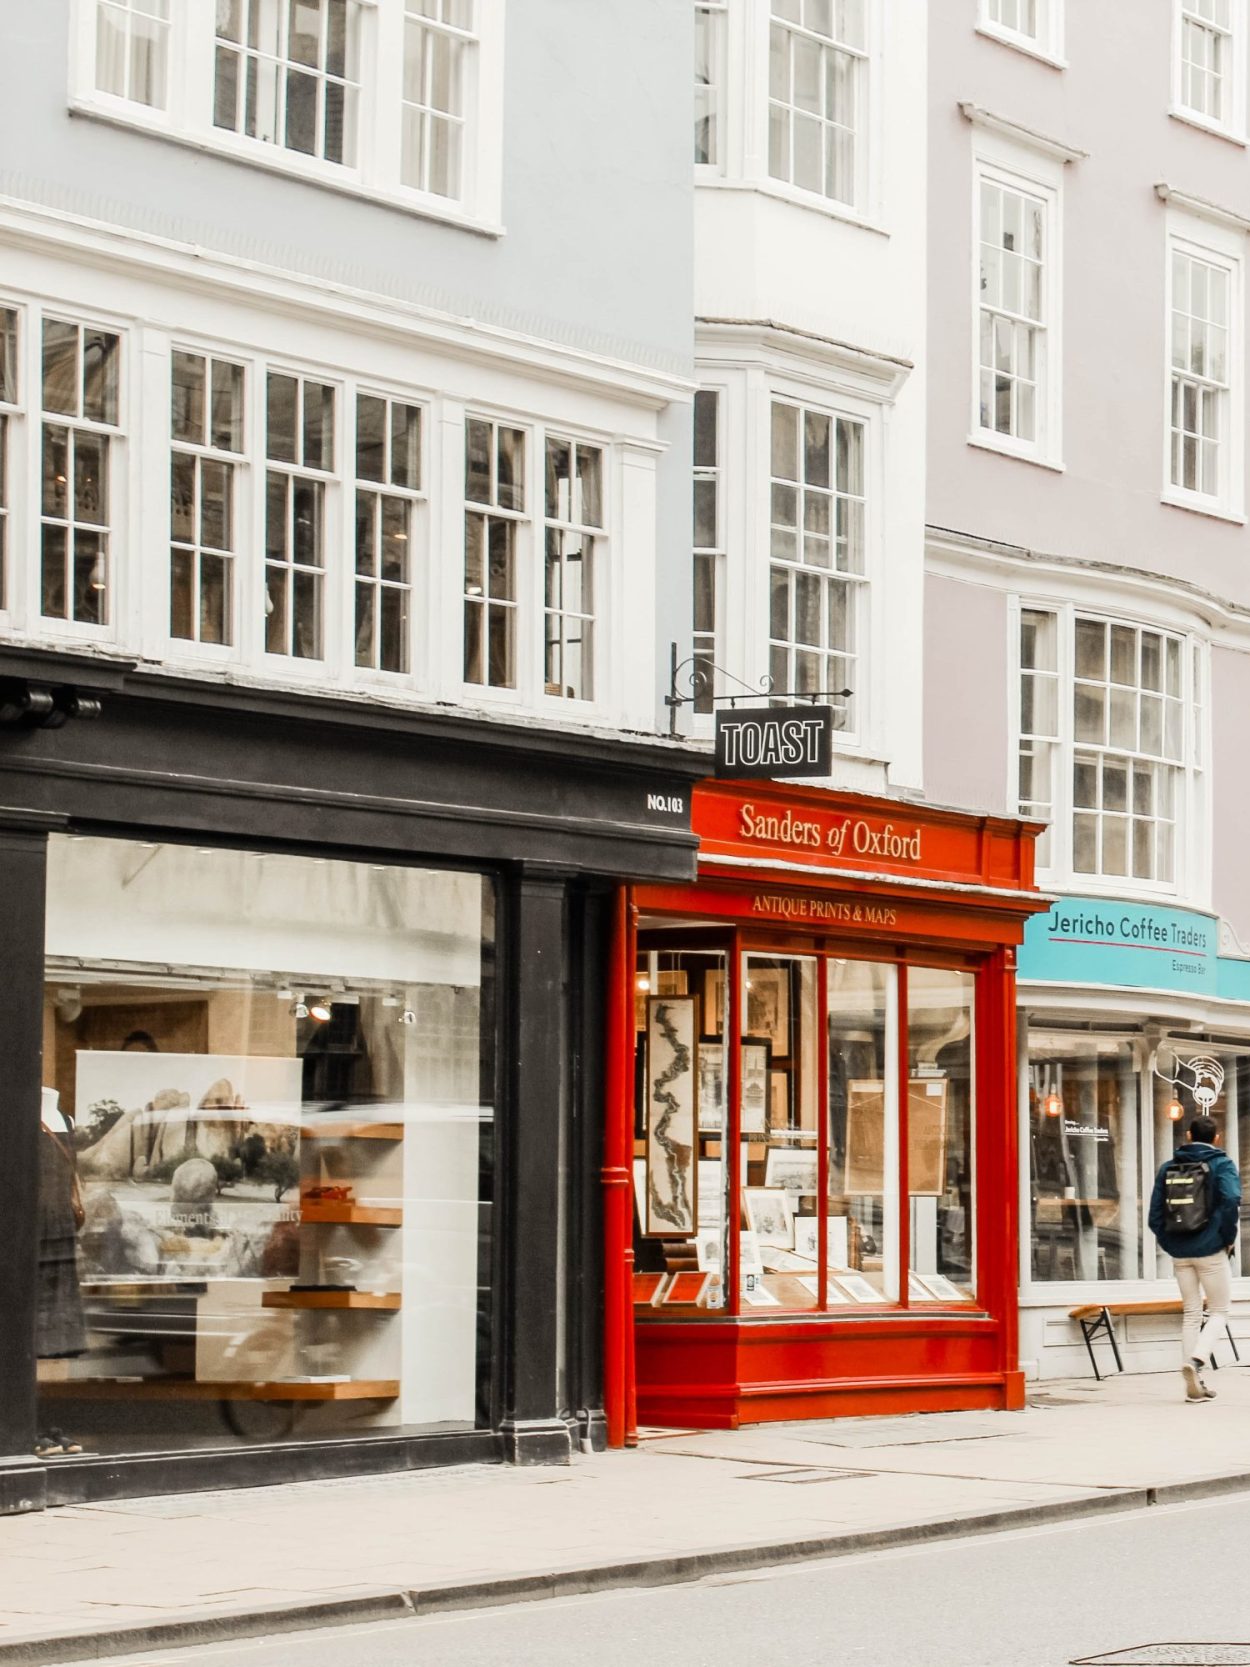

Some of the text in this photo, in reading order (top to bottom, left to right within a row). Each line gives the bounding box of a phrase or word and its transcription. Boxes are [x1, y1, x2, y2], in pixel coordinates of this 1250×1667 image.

[720, 720, 824, 766] TOAST
[647, 794, 683, 813] NO.103
[740, 804, 922, 860] Sanders of Oxford
[752, 896, 897, 925] ANTIQUE PRINTS & MAPS
[1048, 911, 1206, 948] Jericho Coffee Traders
[1172, 959, 1206, 975] Espresso Bar
